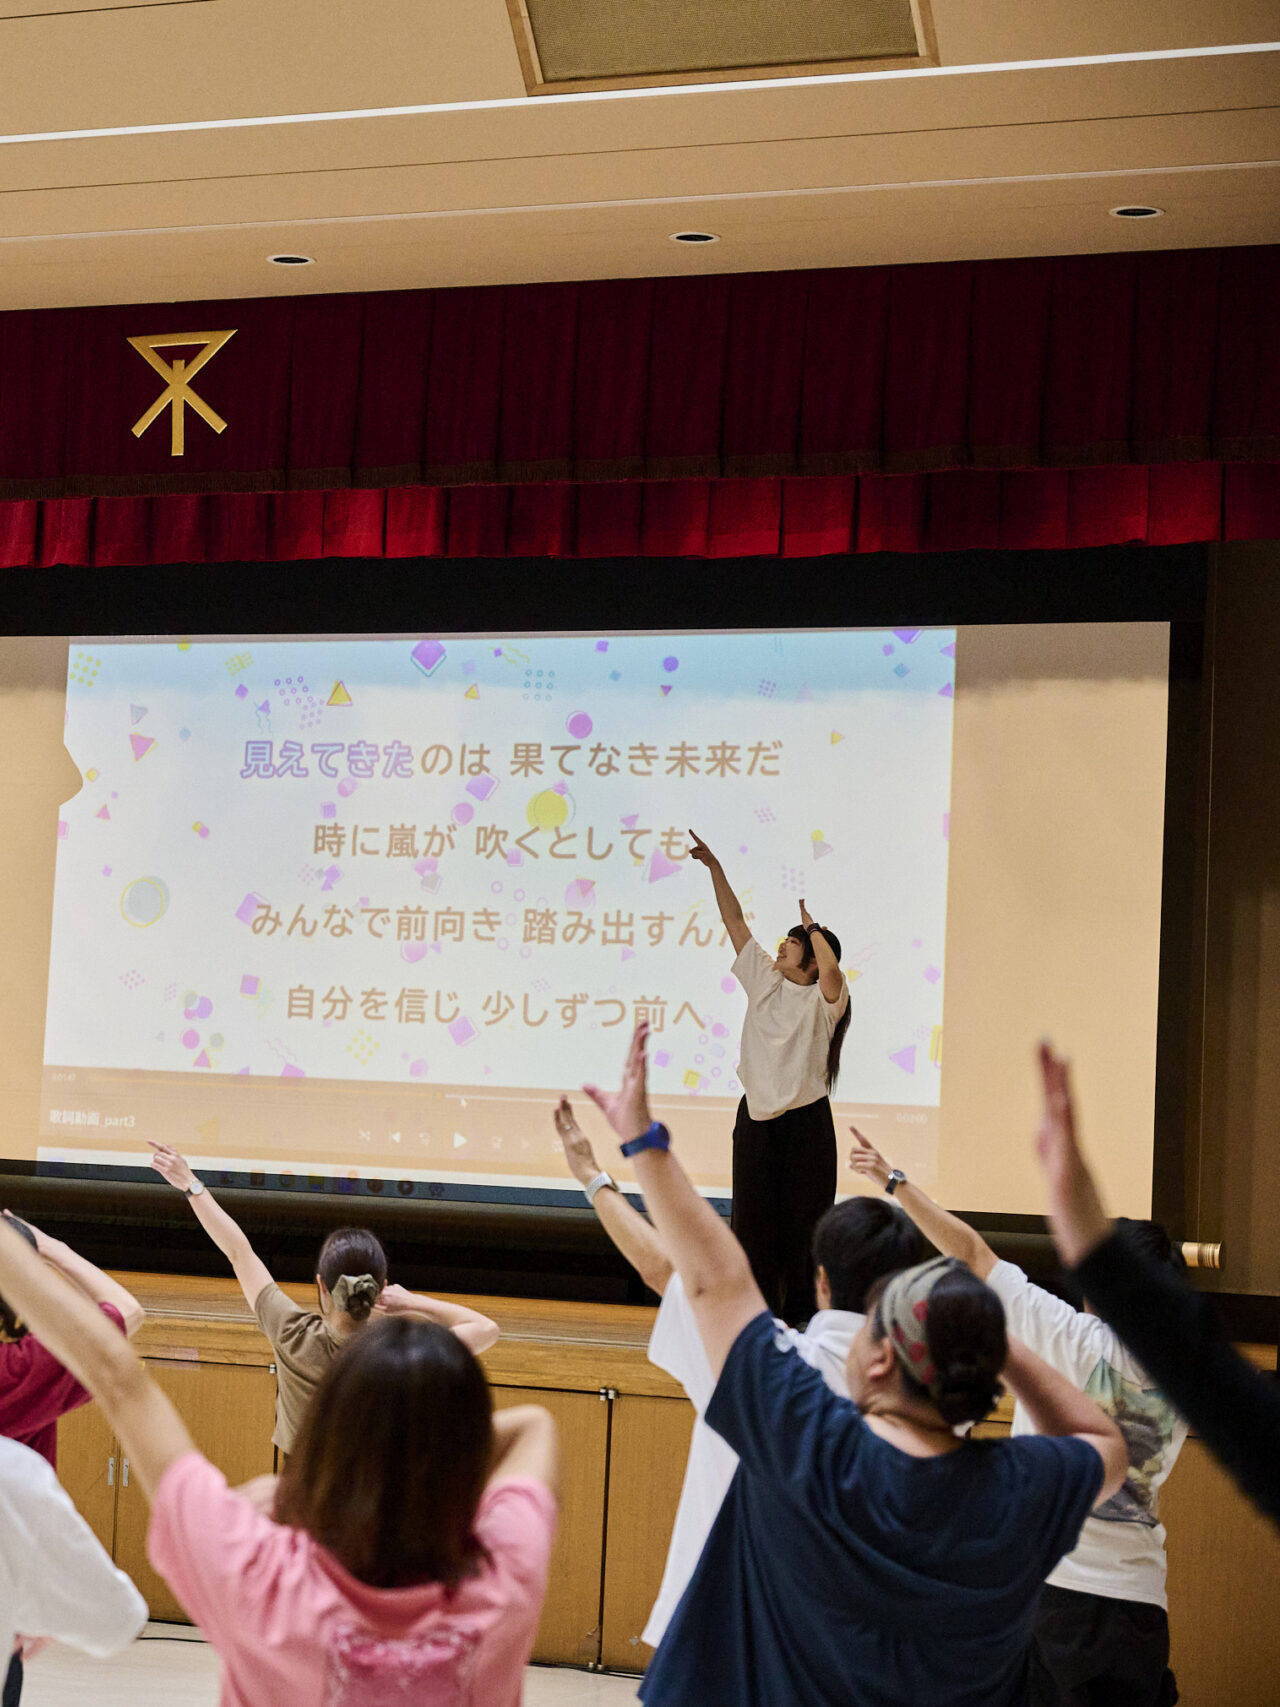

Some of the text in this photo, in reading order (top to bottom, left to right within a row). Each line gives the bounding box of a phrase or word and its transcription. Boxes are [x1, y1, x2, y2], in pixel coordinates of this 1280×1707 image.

[240, 740, 782, 778] 見えてきたのは 果てなき未来だ
[313, 823, 690, 861] 時に嵐が 吹くとしても
[251, 903, 502, 943] みんなで前向き
[287, 984, 705, 1032] 自分を信じ 少しずつ前へ
